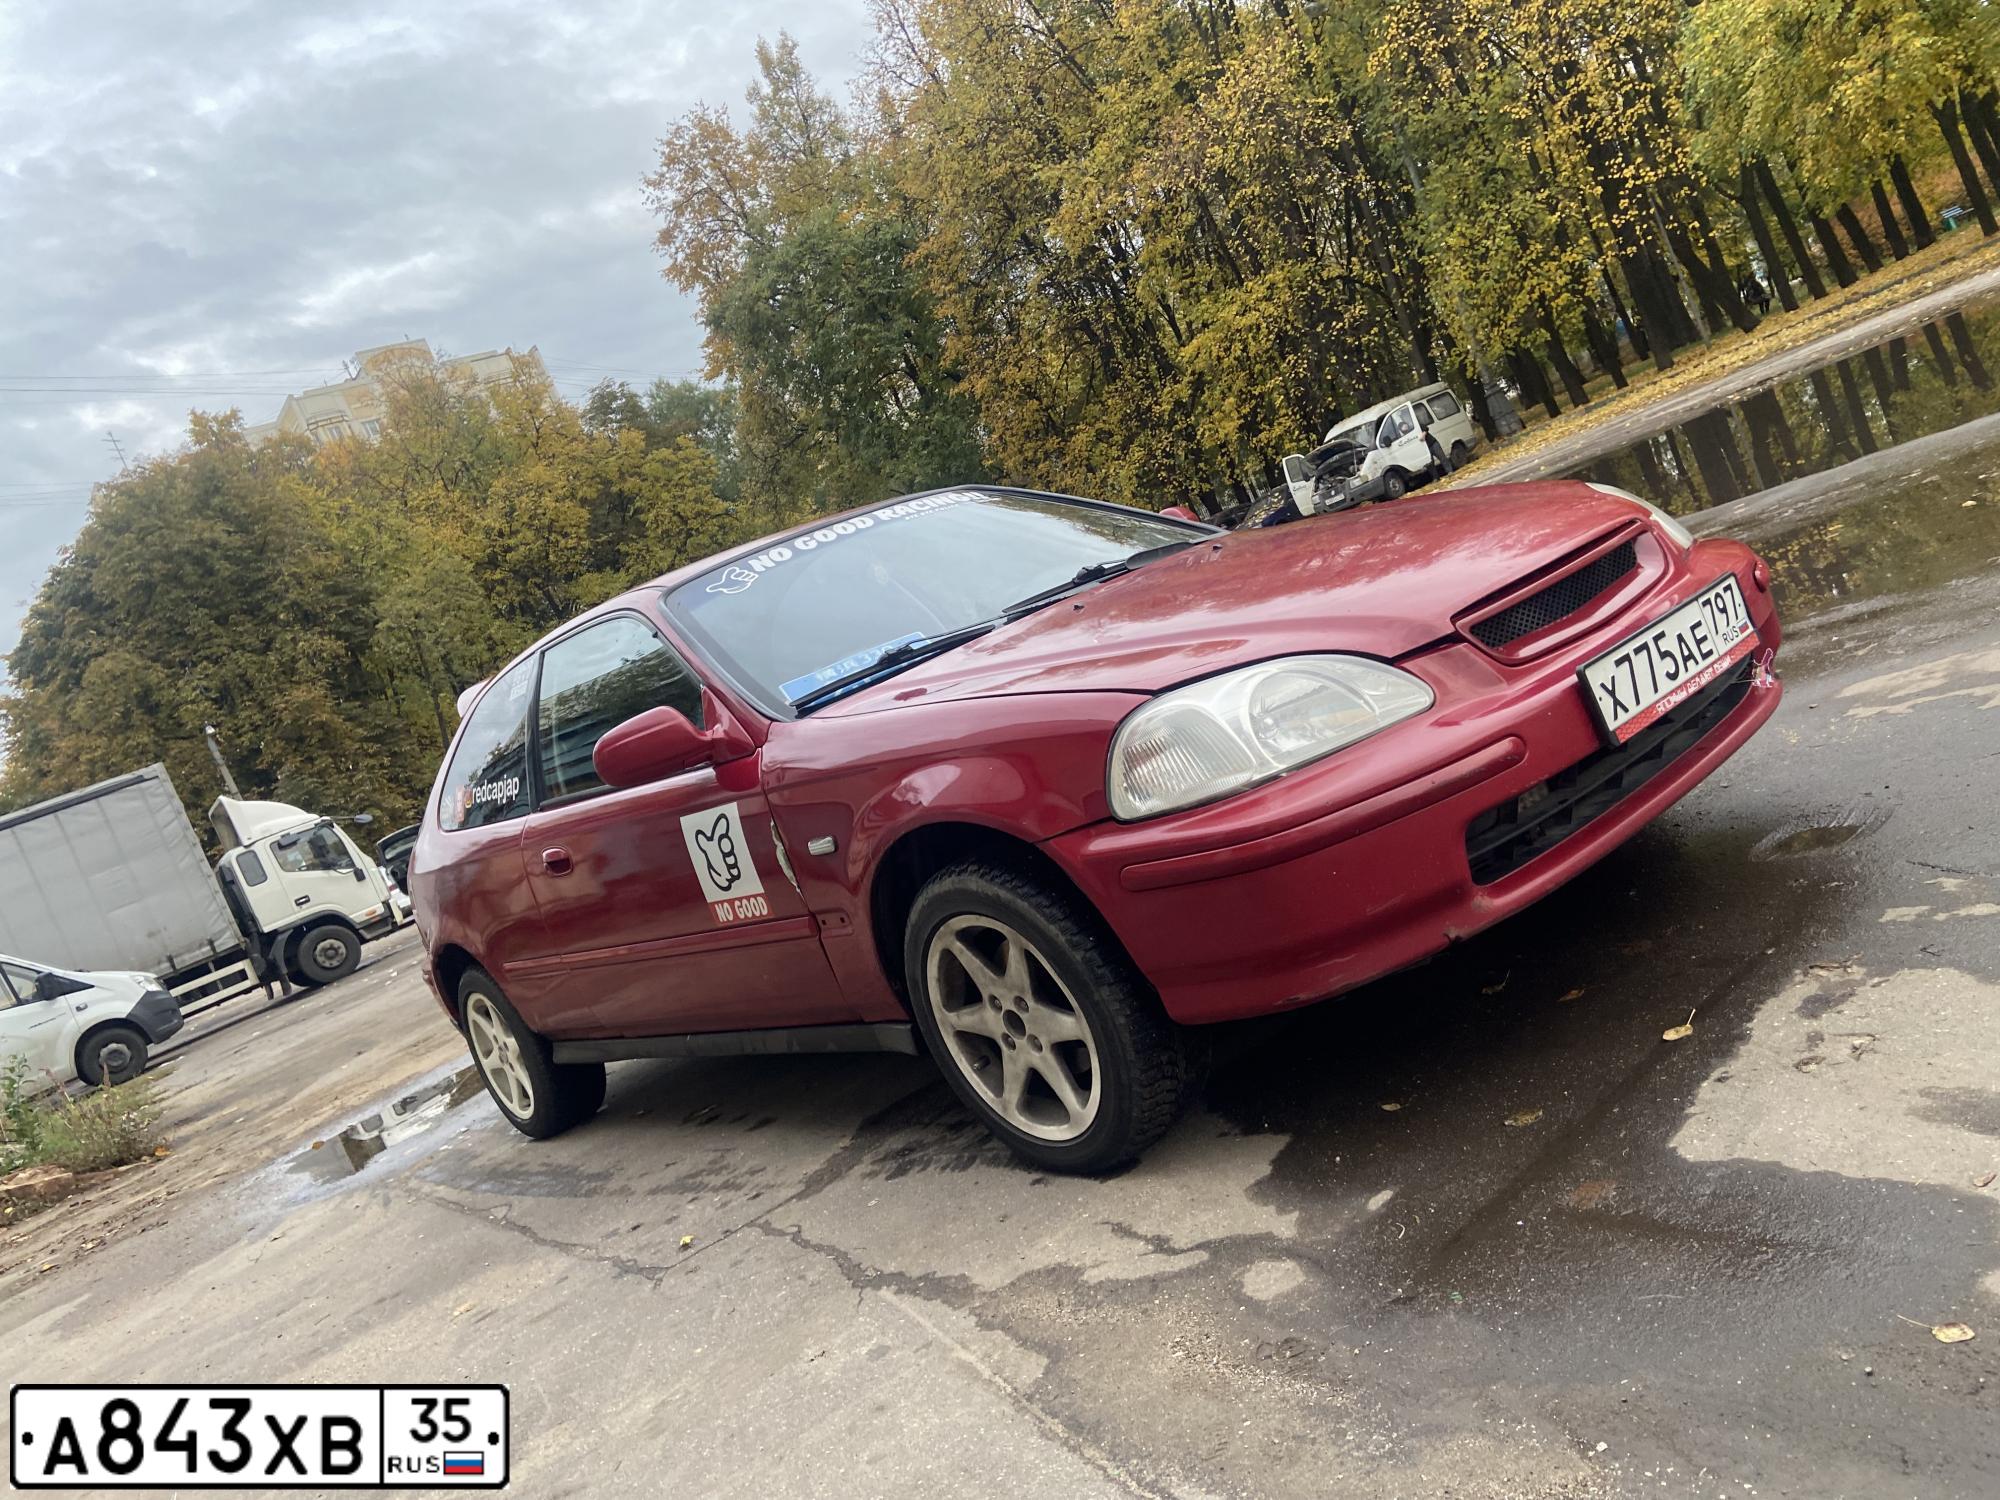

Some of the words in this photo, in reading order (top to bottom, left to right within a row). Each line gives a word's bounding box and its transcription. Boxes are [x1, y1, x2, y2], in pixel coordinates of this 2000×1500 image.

[748, 547, 793, 572] NO
[794, 515, 875, 550] GOOD
[1701, 583, 1739, 636] 797
[1722, 625, 1740, 646] RUS
[472, 774, 520, 805] redcapjap
[715, 902, 734, 922] NO
[734, 896, 768, 919] GOOD
